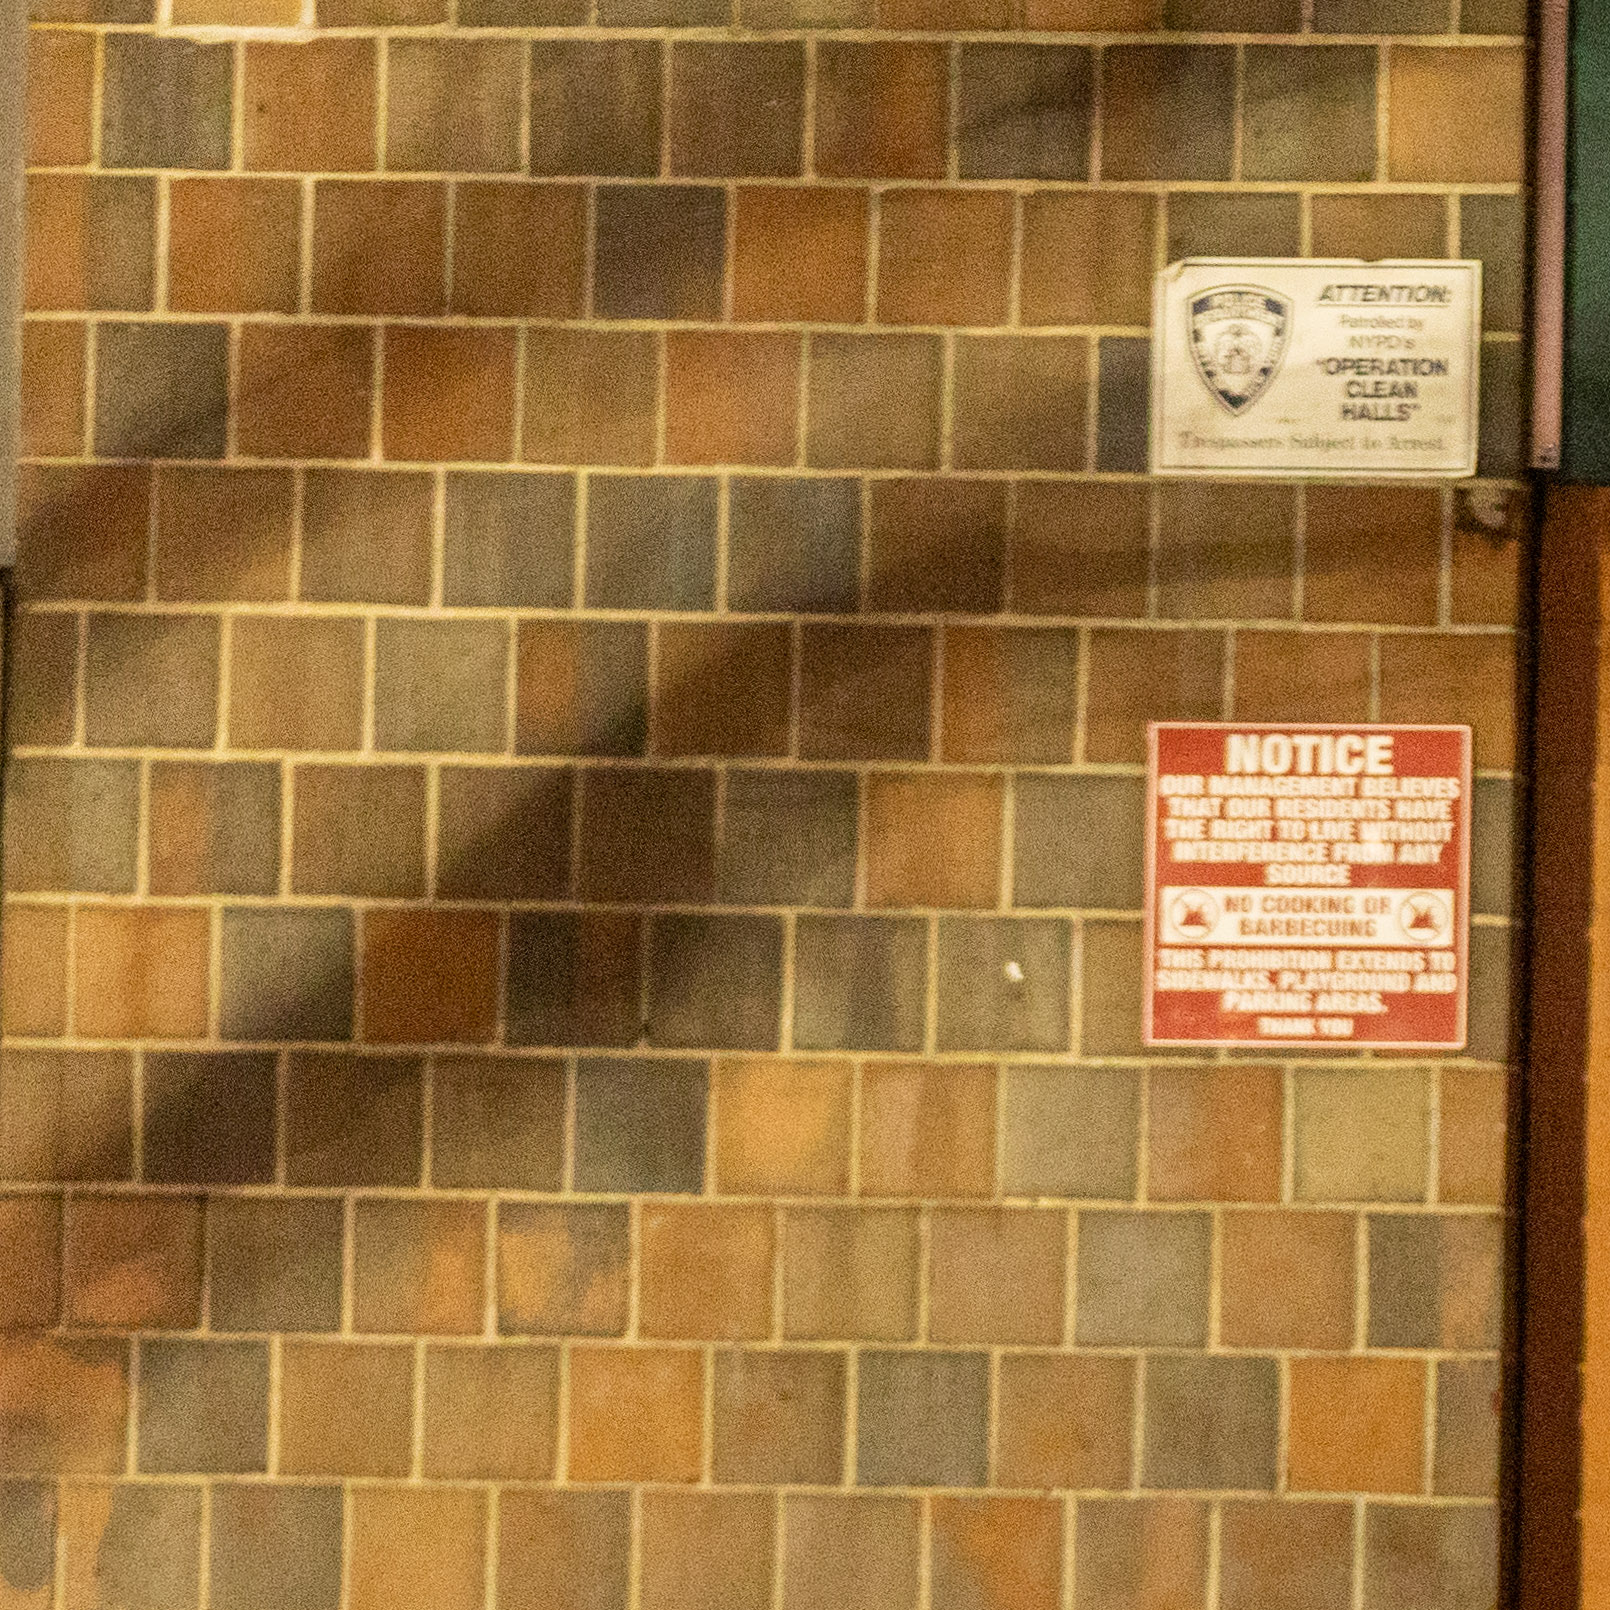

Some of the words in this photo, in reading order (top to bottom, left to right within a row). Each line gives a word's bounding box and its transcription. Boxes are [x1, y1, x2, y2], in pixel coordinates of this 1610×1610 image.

[1346, 380, 1418, 398] CLEAN
[1225, 734, 1394, 775] NOTICE
[1160, 775, 1205, 796] OUR
[1208, 775, 1357, 797] MANAGEMENT
[1360, 777, 1460, 798] BELIEVES
[1167, 798, 1222, 817] THAT
[1225, 798, 1271, 818] OUR
[1275, 799, 1391, 819] RESIDENTS
[1394, 800, 1452, 820] HAVE
[1164, 819, 1206, 839] THE
[1209, 820, 1274, 840] RIGHT
[1277, 820, 1306, 840] TO
[1308, 821, 1356, 841] LIVE
[1359, 822, 1454, 842] WITHOUT
[1171, 841, 1329, 863] INTERFERENCE
[1332, 843, 1395, 864] FROM
[1396, 844, 1443, 864] ANY
[1225, 895, 1253, 913] NO
[1261, 896, 1355, 914] COOKING
[1364, 897, 1391, 914] OR
[1335, 950, 1426, 971] EXTENDS
[1220, 990, 1312, 1013] PARKING
